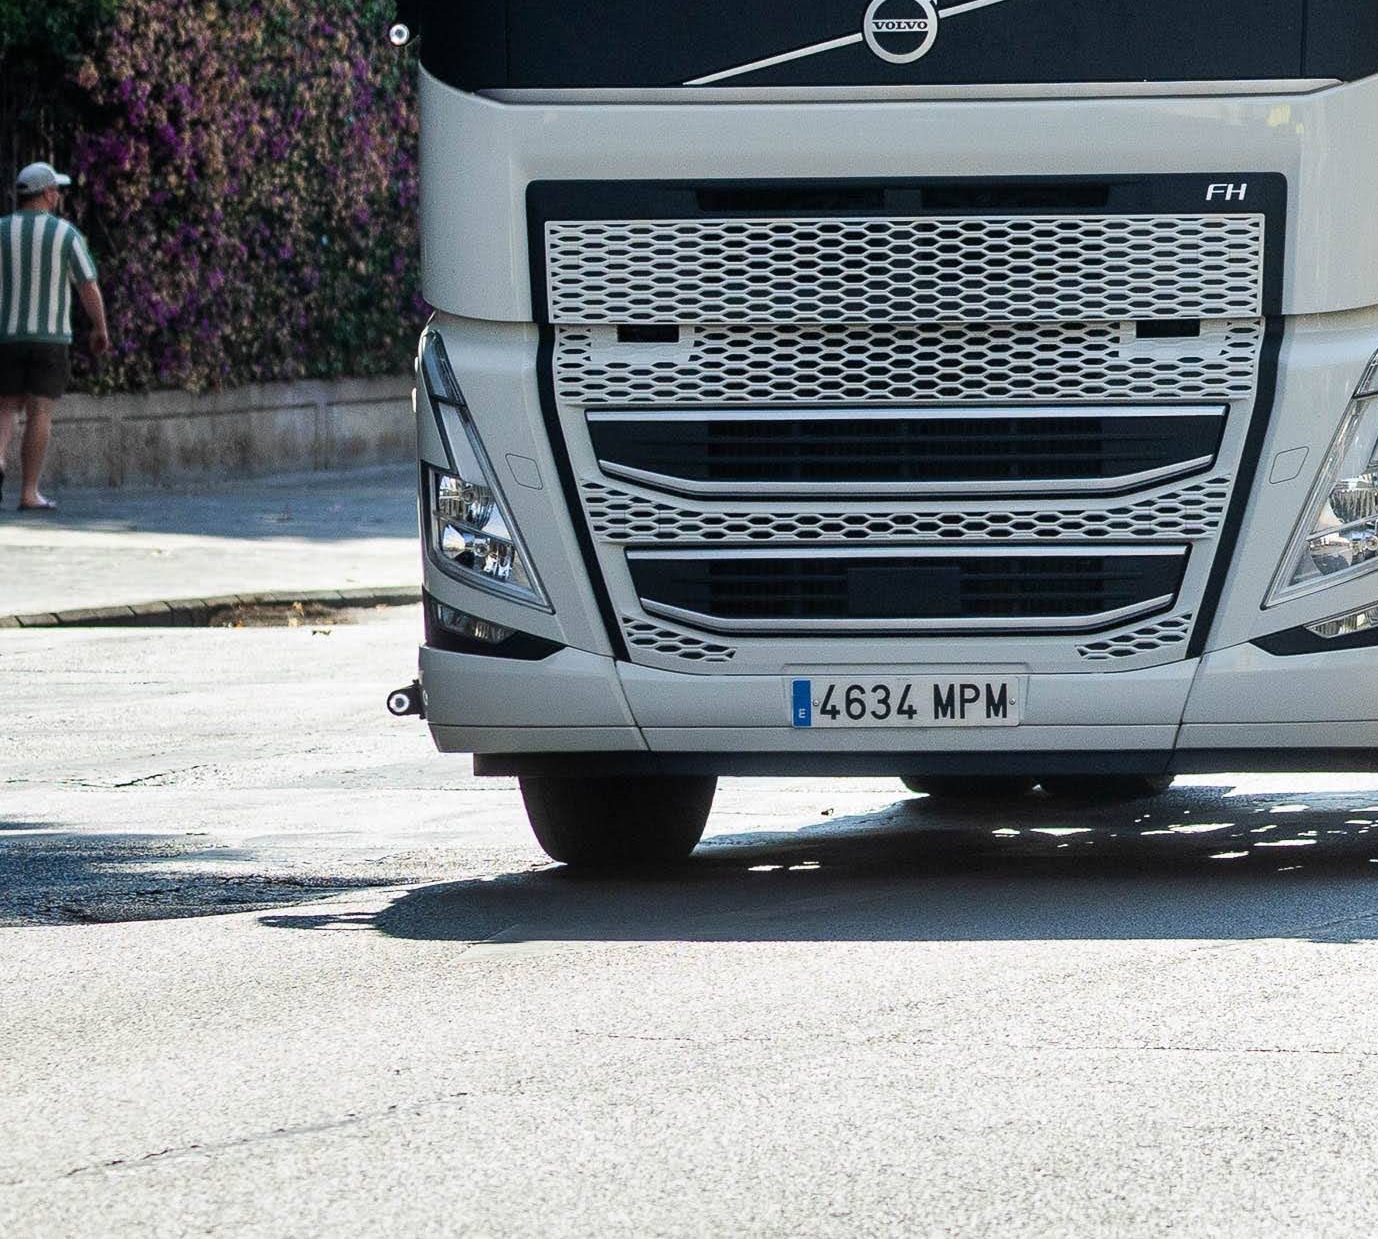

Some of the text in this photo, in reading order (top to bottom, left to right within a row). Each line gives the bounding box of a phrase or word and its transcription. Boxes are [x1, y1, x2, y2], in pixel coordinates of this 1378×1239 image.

[872, 21, 928, 30] VOLVO
[1205, 183, 1247, 201] FH
[820, 684, 918, 721] 4634
[933, 683, 1008, 720] MPM
